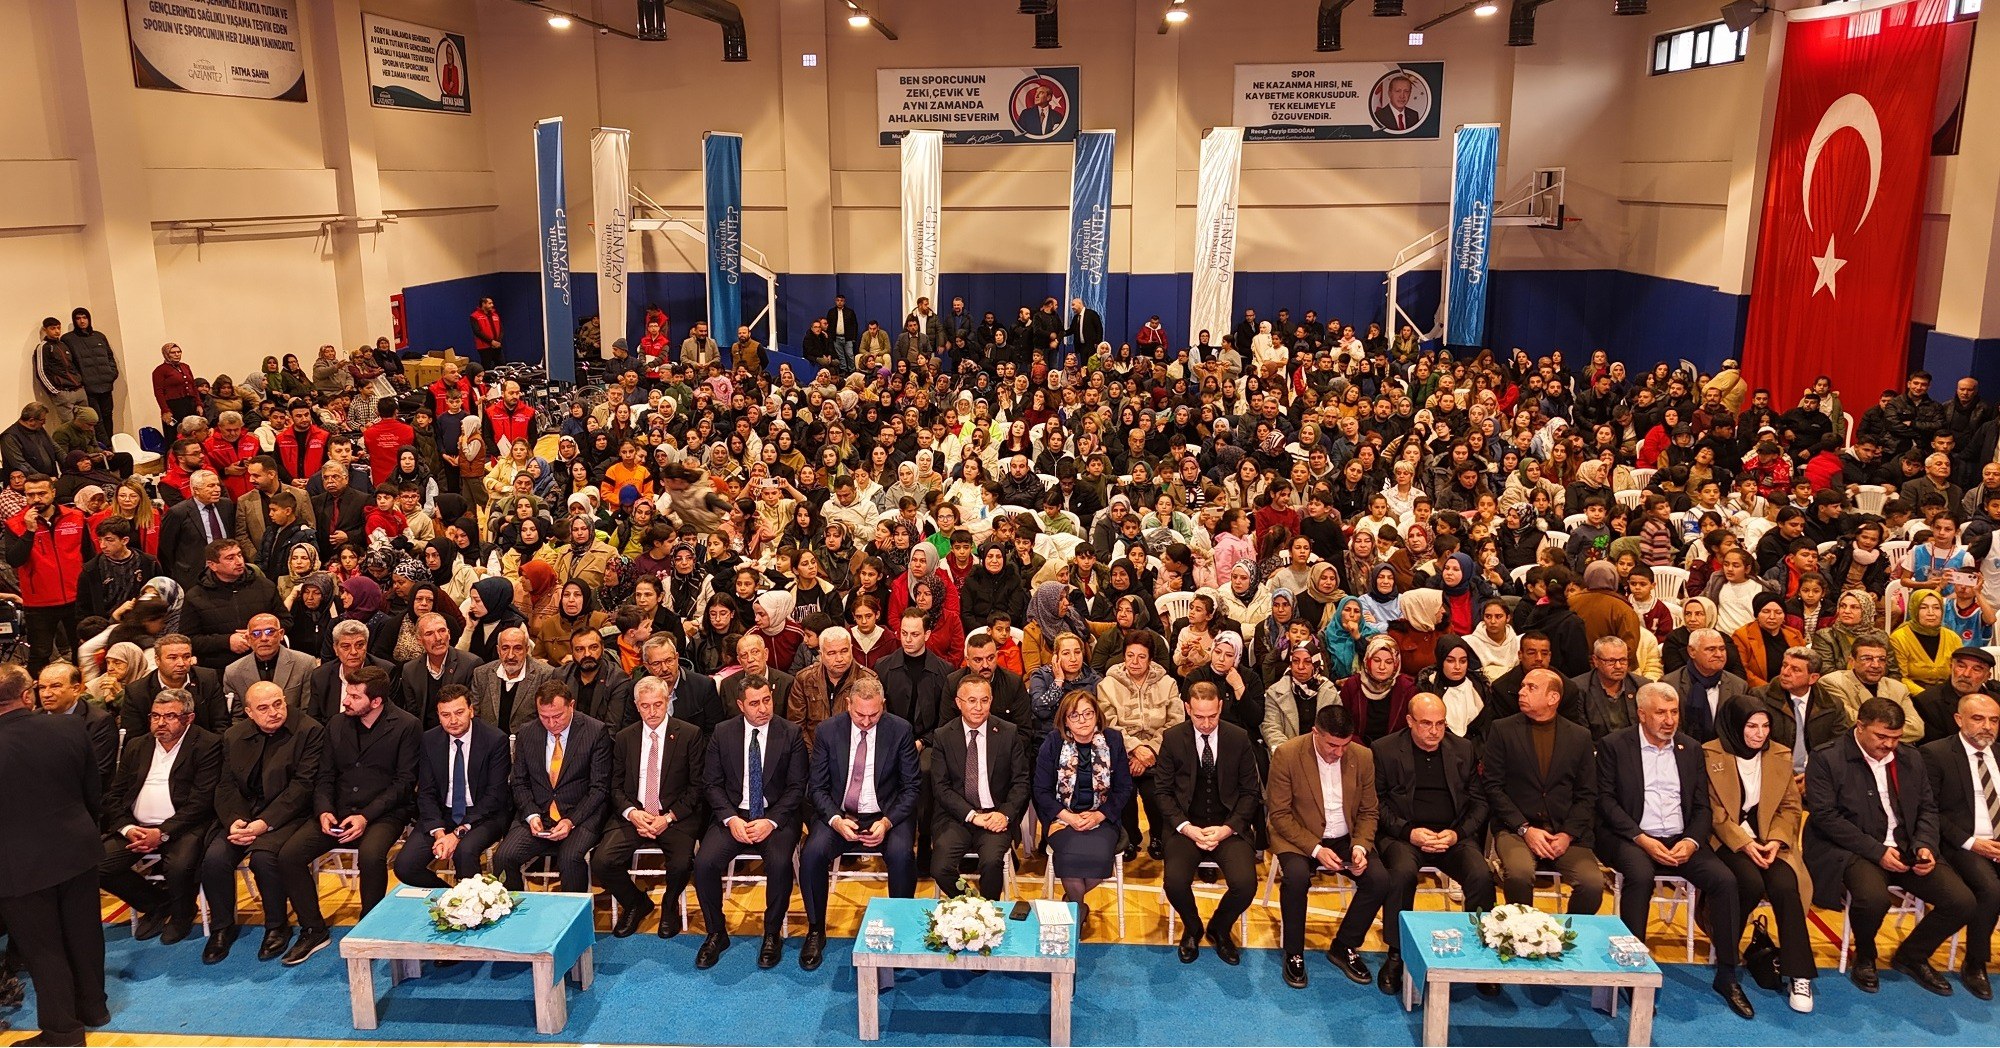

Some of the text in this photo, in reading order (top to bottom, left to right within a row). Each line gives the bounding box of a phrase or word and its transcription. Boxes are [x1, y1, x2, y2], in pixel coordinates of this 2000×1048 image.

[238, 0, 260, 13] AYAKTA
[261, 5, 281, 17] TUTAN
[280, 9, 288, 19] VE
[197, 9, 226, 24] SAĞLIKLI
[226, 15, 251, 28] YAŞAMA
[273, 23, 288, 35] EDEN
[143, 18, 173, 34] SPORUN
[173, 23, 184, 35] VE
[184, 25, 224, 42] SPORCUNUN
[225, 32, 238, 43] HER
[239, 34, 260, 46] ZAMAN
[231, 65, 252, 77] FATMA
[1291, 70, 1315, 78] SPOR
[899, 75, 986, 85] BEN SPORCUNUN
[1253, 80, 1353, 90] NE KAZANMA HIRSI, NE
[965, 88, 980, 97] VE
[1245, 91, 1360, 100] KAYBETME KORKUSUDUR.
[902, 100, 984, 110] AYNI ZAMANDA
[1268, 102, 1285, 110] TEK
[888, 113, 1000, 123] AHLAKLISINI SEVERİM
